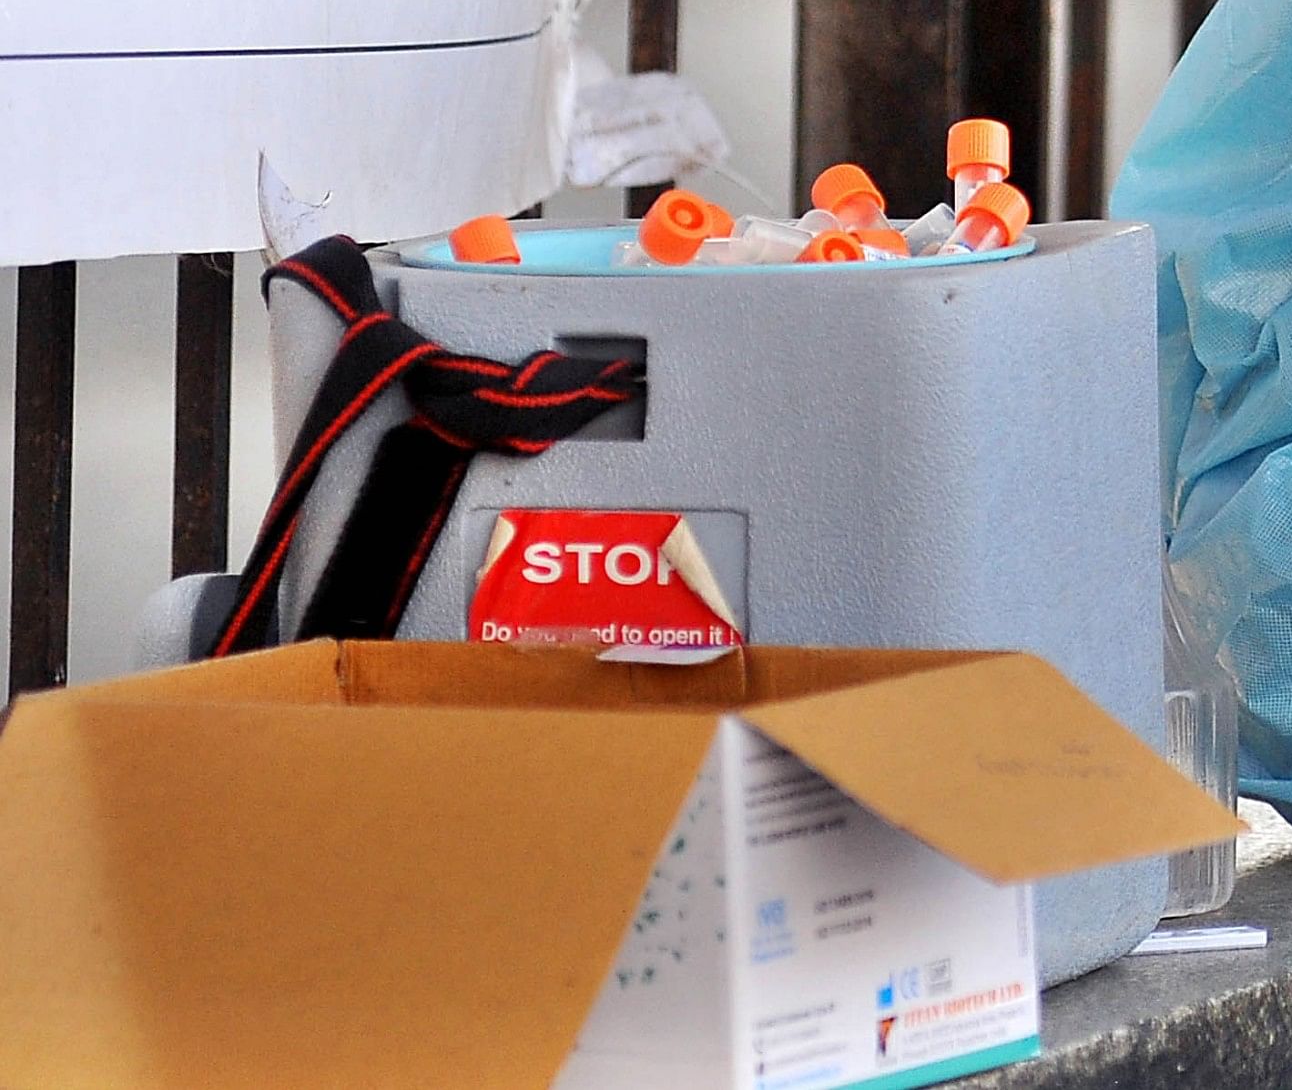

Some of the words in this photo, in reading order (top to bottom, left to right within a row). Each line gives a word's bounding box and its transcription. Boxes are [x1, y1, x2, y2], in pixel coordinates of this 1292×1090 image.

[481, 621, 511, 642] Do
[621, 624, 643, 645] to
[648, 629, 702, 647] open
[709, 625, 723, 645] it
